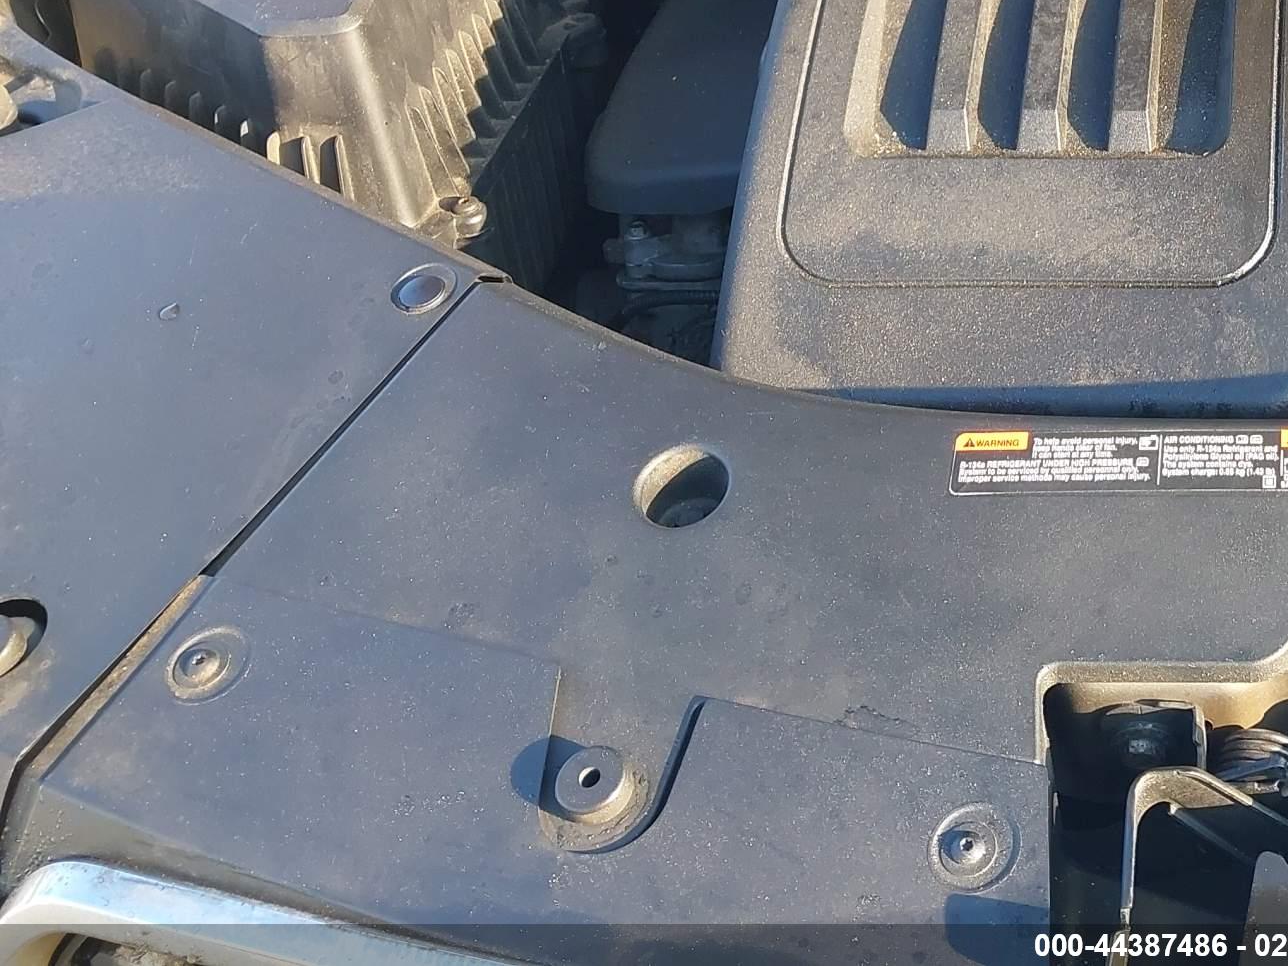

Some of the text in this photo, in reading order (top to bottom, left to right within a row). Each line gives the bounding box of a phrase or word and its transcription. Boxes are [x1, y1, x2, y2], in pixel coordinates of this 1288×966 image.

[976, 438, 1020, 447] WARNING
[1164, 436, 1234, 444] AIR CONDITIONING
